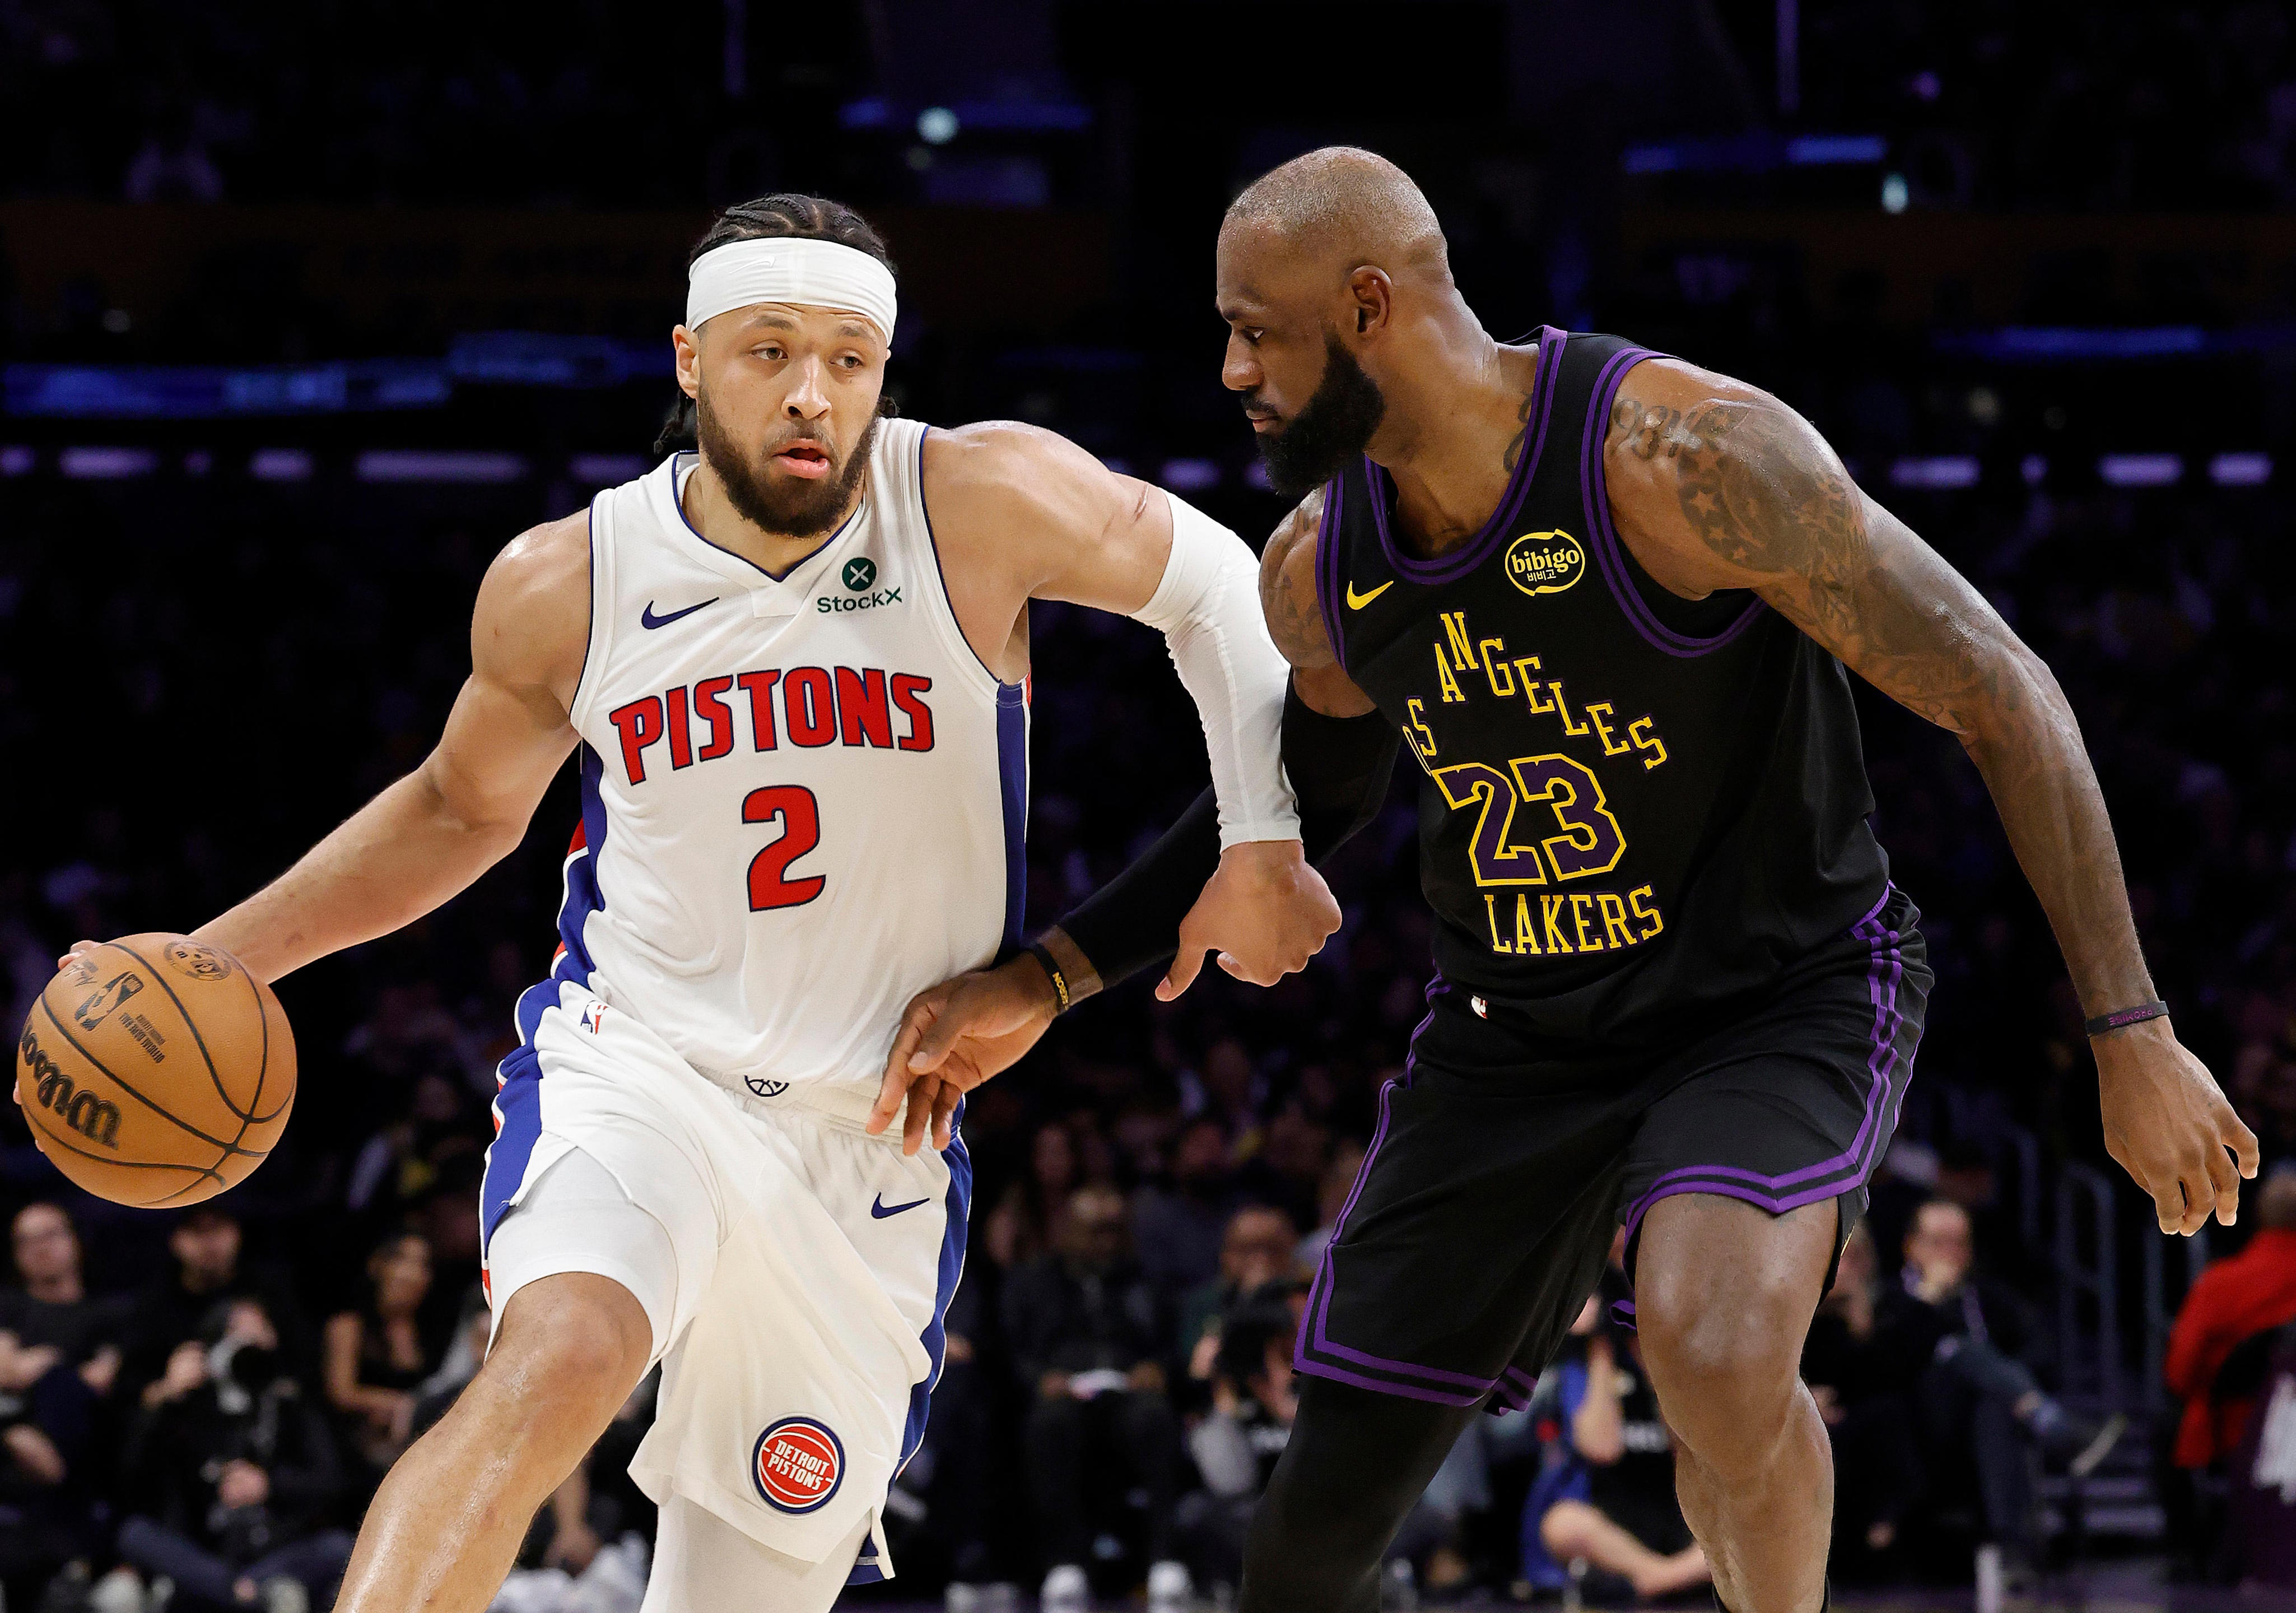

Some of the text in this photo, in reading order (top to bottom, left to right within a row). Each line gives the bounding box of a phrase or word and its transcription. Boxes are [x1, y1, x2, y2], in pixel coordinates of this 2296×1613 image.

[1511, 547, 1580, 573] bibigo
[1526, 569, 1557, 582] 비비고
[816, 586, 903, 614] StockX
[1433, 611, 1668, 771] ANGELES
[608, 666, 935, 786] PISTONS
[1430, 752, 1627, 887] 23
[741, 784, 827, 913] 2
[1483, 884, 1664, 955] LAKERS
[767, 1453, 824, 1491] PISTONS
[774, 1439, 830, 1476] DETROIT
